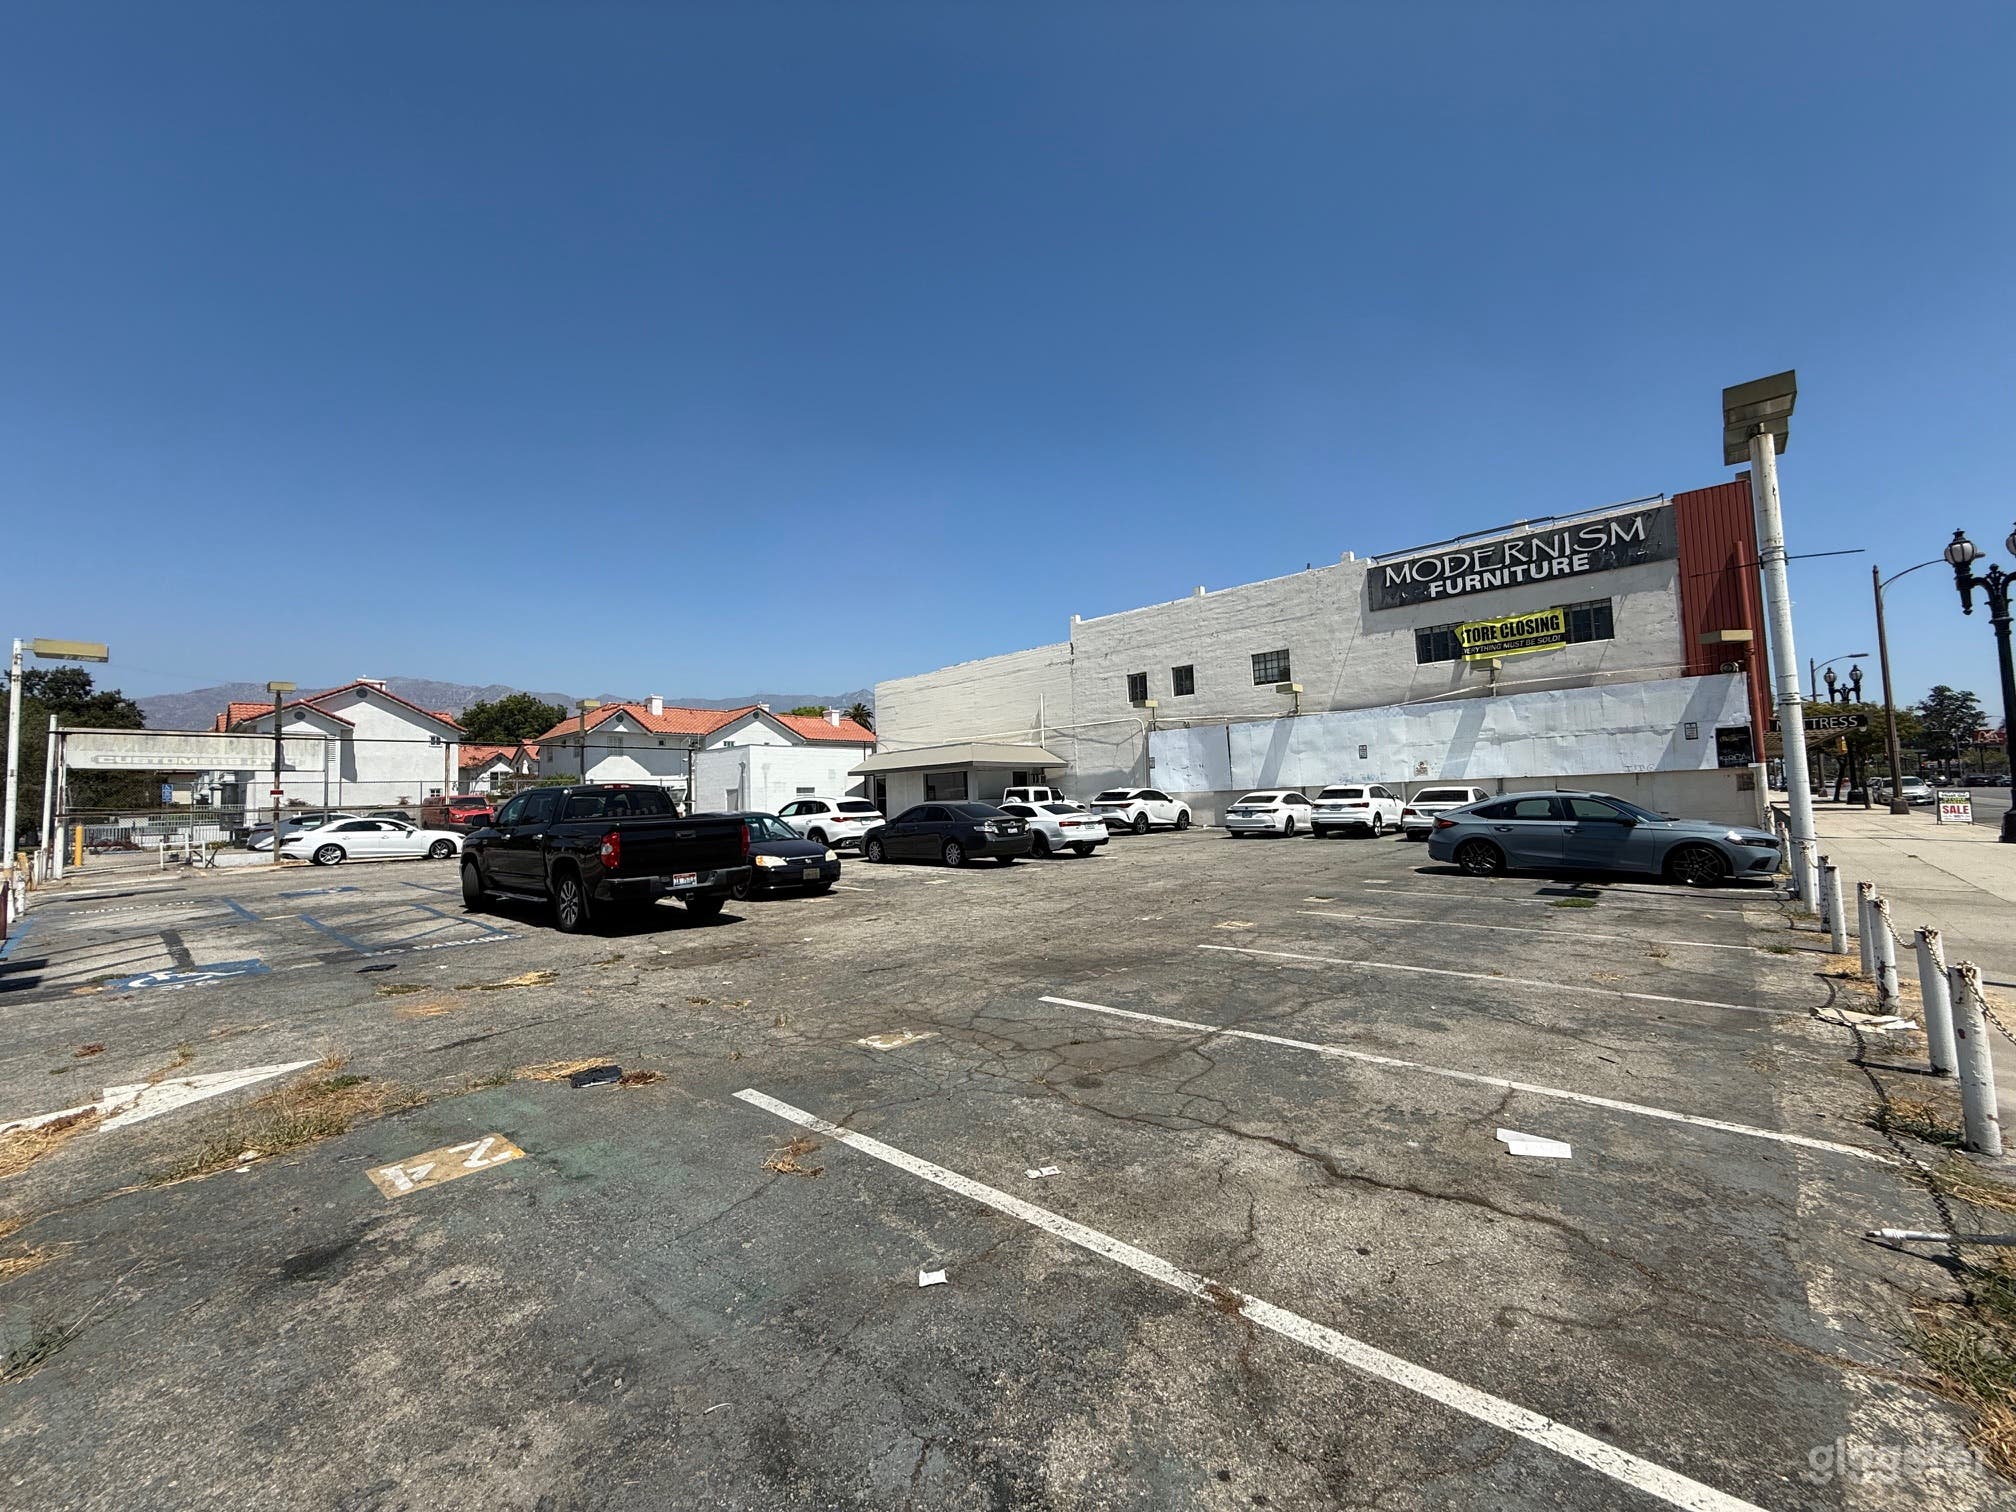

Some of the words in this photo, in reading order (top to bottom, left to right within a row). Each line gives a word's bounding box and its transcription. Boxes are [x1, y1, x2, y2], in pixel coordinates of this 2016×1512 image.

[1384, 516, 1646, 588] MODERNISM
[1429, 553, 1590, 598] FURNITURE
[1500, 615, 1560, 638] CLOSING
[1463, 643, 1501, 655] VERYTHING
[1503, 640, 1524, 650] MUST
[1525, 638, 1536, 646] BE
[1537, 634, 1561, 644] SOLD!
[98, 756, 241, 767] CUSTOMERS
[1942, 805, 1970, 815] SALE
